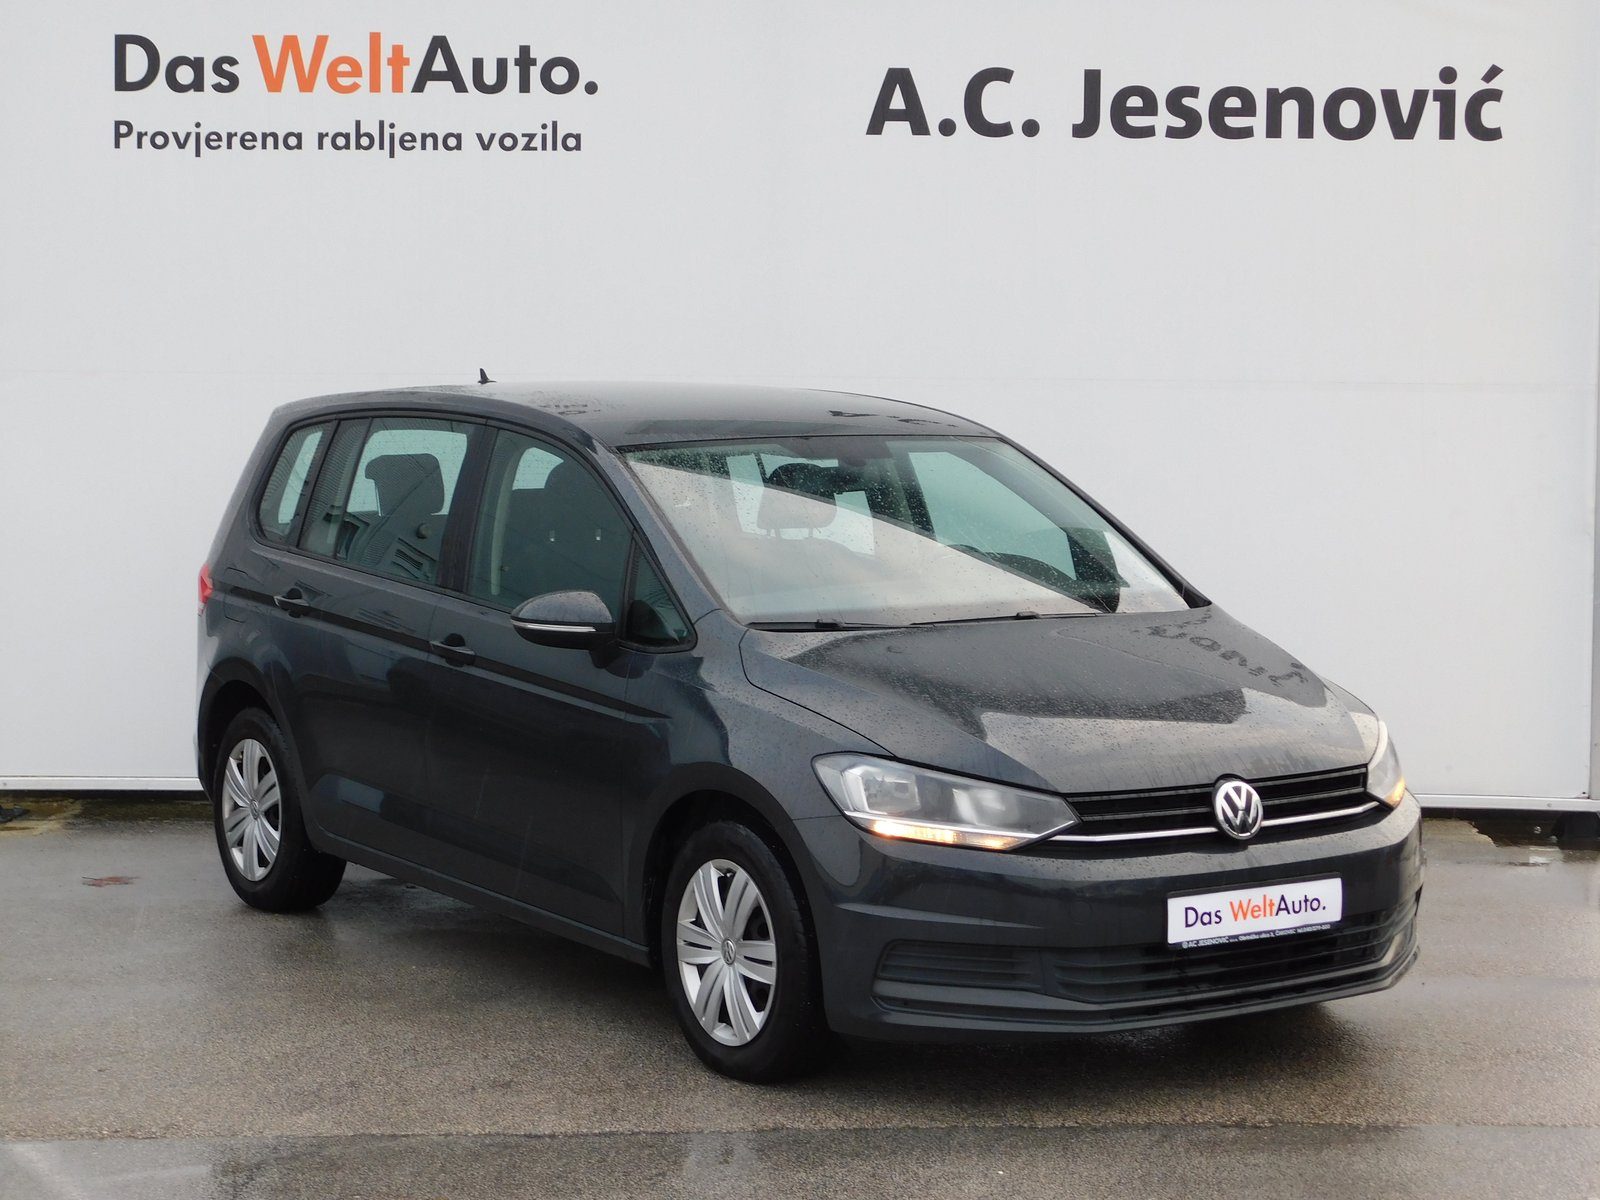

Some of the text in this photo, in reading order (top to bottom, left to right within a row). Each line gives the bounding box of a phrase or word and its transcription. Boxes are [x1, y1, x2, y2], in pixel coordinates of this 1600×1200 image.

[114, 32, 599, 96] Das WeltAuto.
[866, 64, 1504, 142] A.C. Jesenović
[114, 119, 582, 159] Provjerena rabljena vozila
[1184, 893, 1327, 928] Das WeltAuto.
